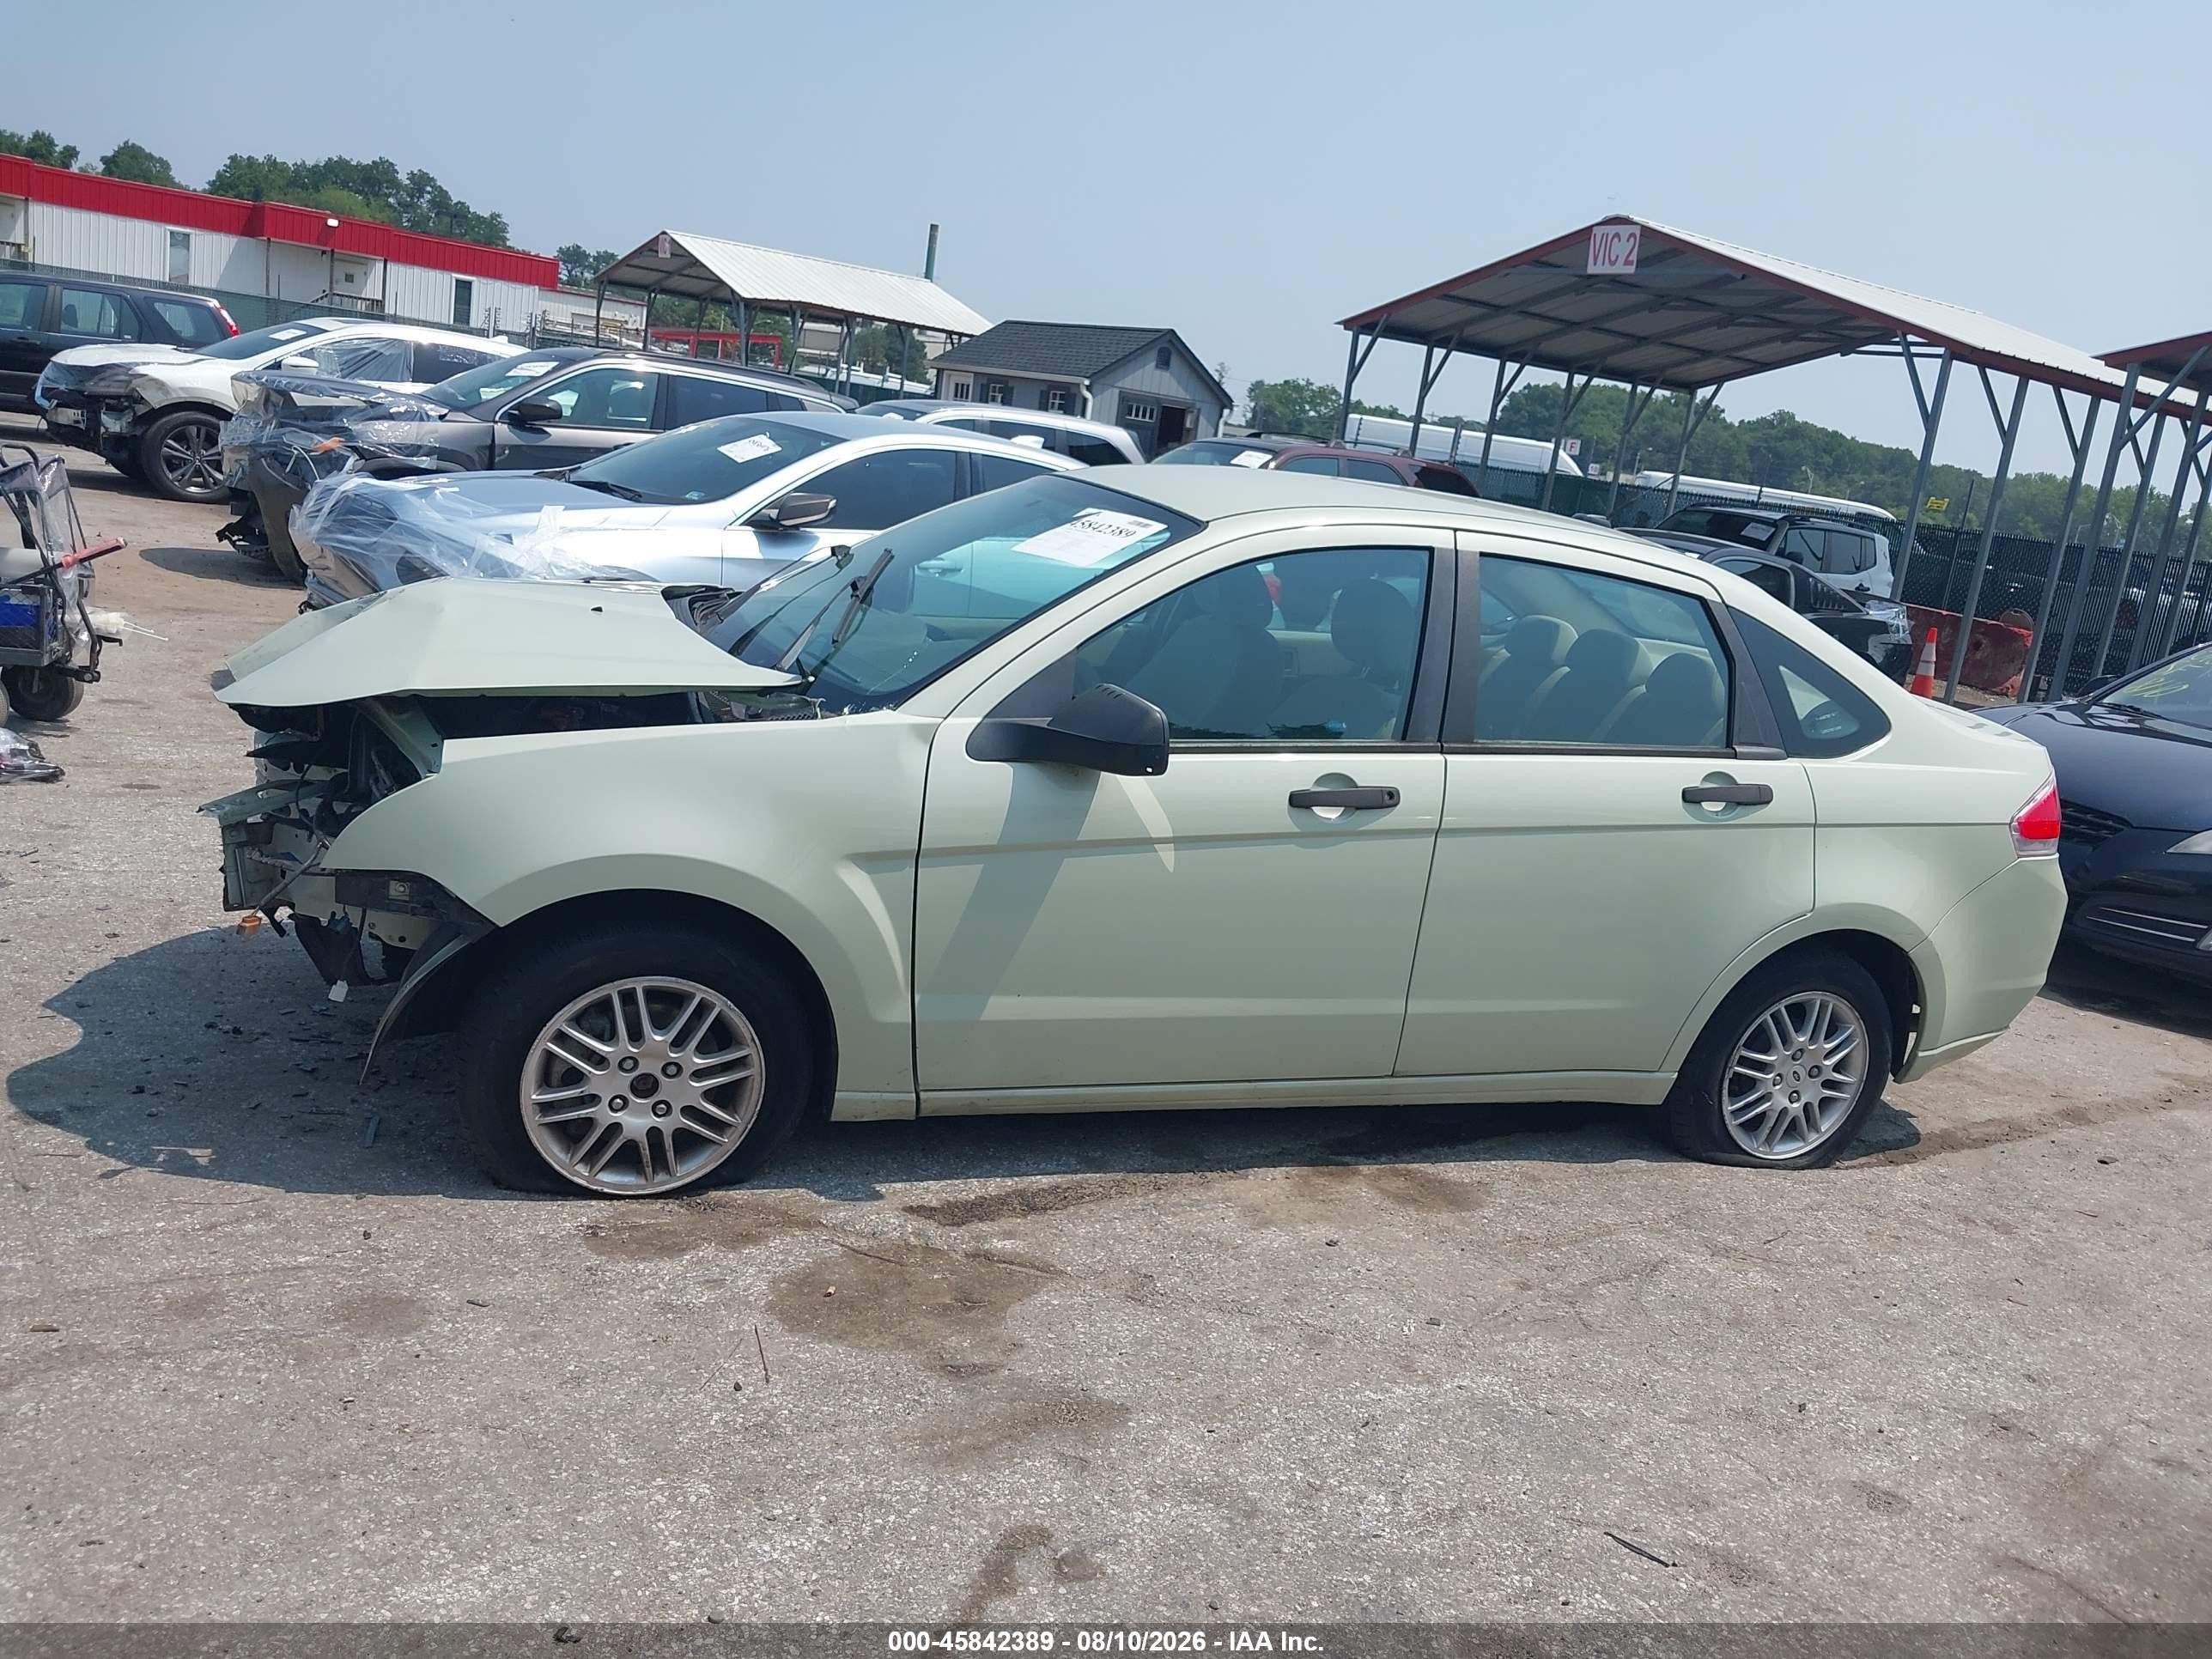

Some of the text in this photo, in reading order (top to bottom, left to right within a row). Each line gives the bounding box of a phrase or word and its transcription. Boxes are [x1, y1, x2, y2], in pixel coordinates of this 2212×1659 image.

[1592, 232, 1638, 267] VIC 2
[1569, 441, 1577, 453] F
